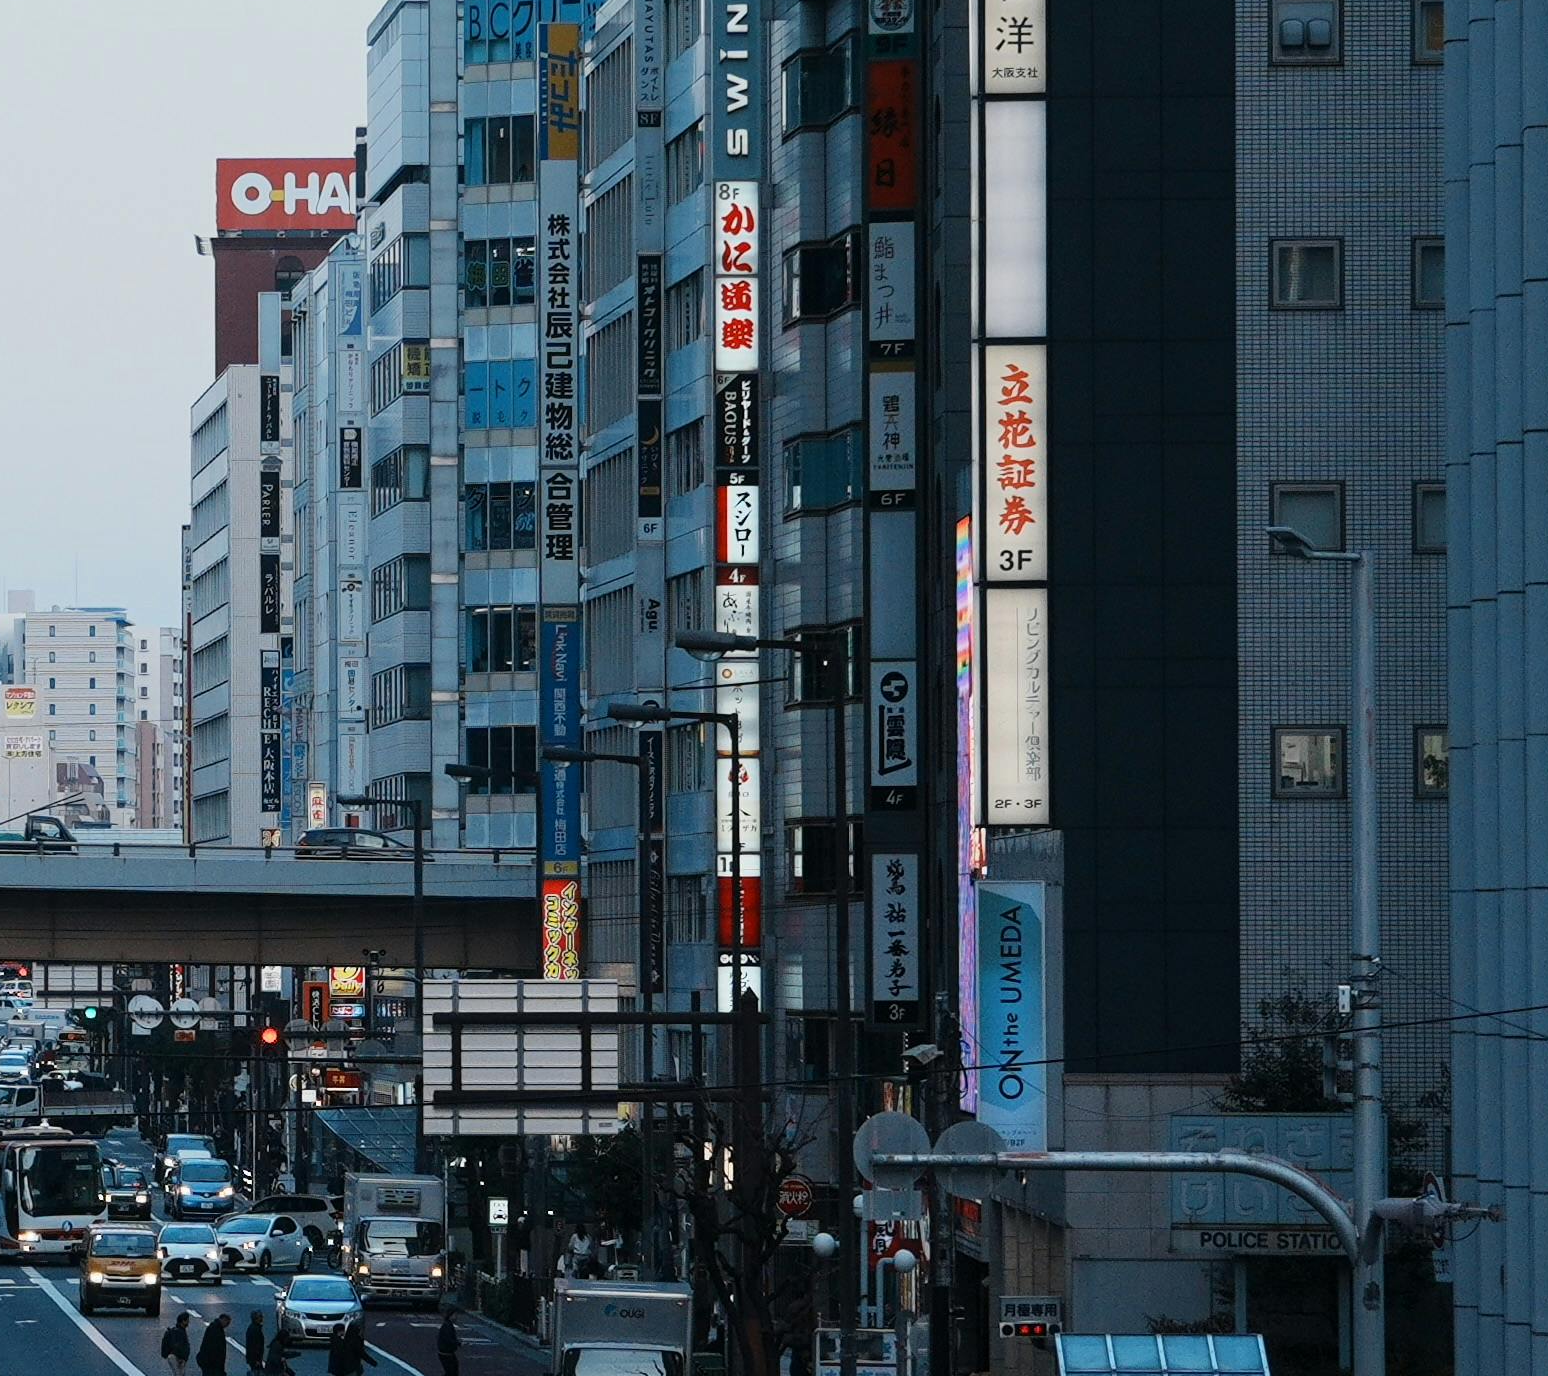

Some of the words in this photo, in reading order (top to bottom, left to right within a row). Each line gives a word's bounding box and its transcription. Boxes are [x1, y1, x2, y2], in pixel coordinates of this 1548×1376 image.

[992, 67, 1039, 79] 大阪支社
[718, 183, 740, 201] 8F
[880, 342, 904, 358] 7F
[996, 364, 1037, 536] 立花証券
[729, 473, 745, 484] 5F
[262, 484, 275, 528] PARLER
[881, 493, 906, 505] 6F
[643, 523, 657, 535] 6F
[735, 491, 753, 558] スシロー
[999, 550, 1033, 571] 3F
[728, 568, 746, 583] 4F
[648, 598, 660, 634] Agu.
[886, 785, 904, 801] 4F
[1000, 905, 1023, 1004] UMEDA
[888, 1006, 906, 1022] 3F
[779, 1190, 811, 1206] 消火栓
[1200, 1231, 1269, 1249] POLICE
[1277, 1231, 1343, 1250] STATIO
[619, 1307, 647, 1320] OUGI
[1003, 1304, 1058, 1319] 月極専用
